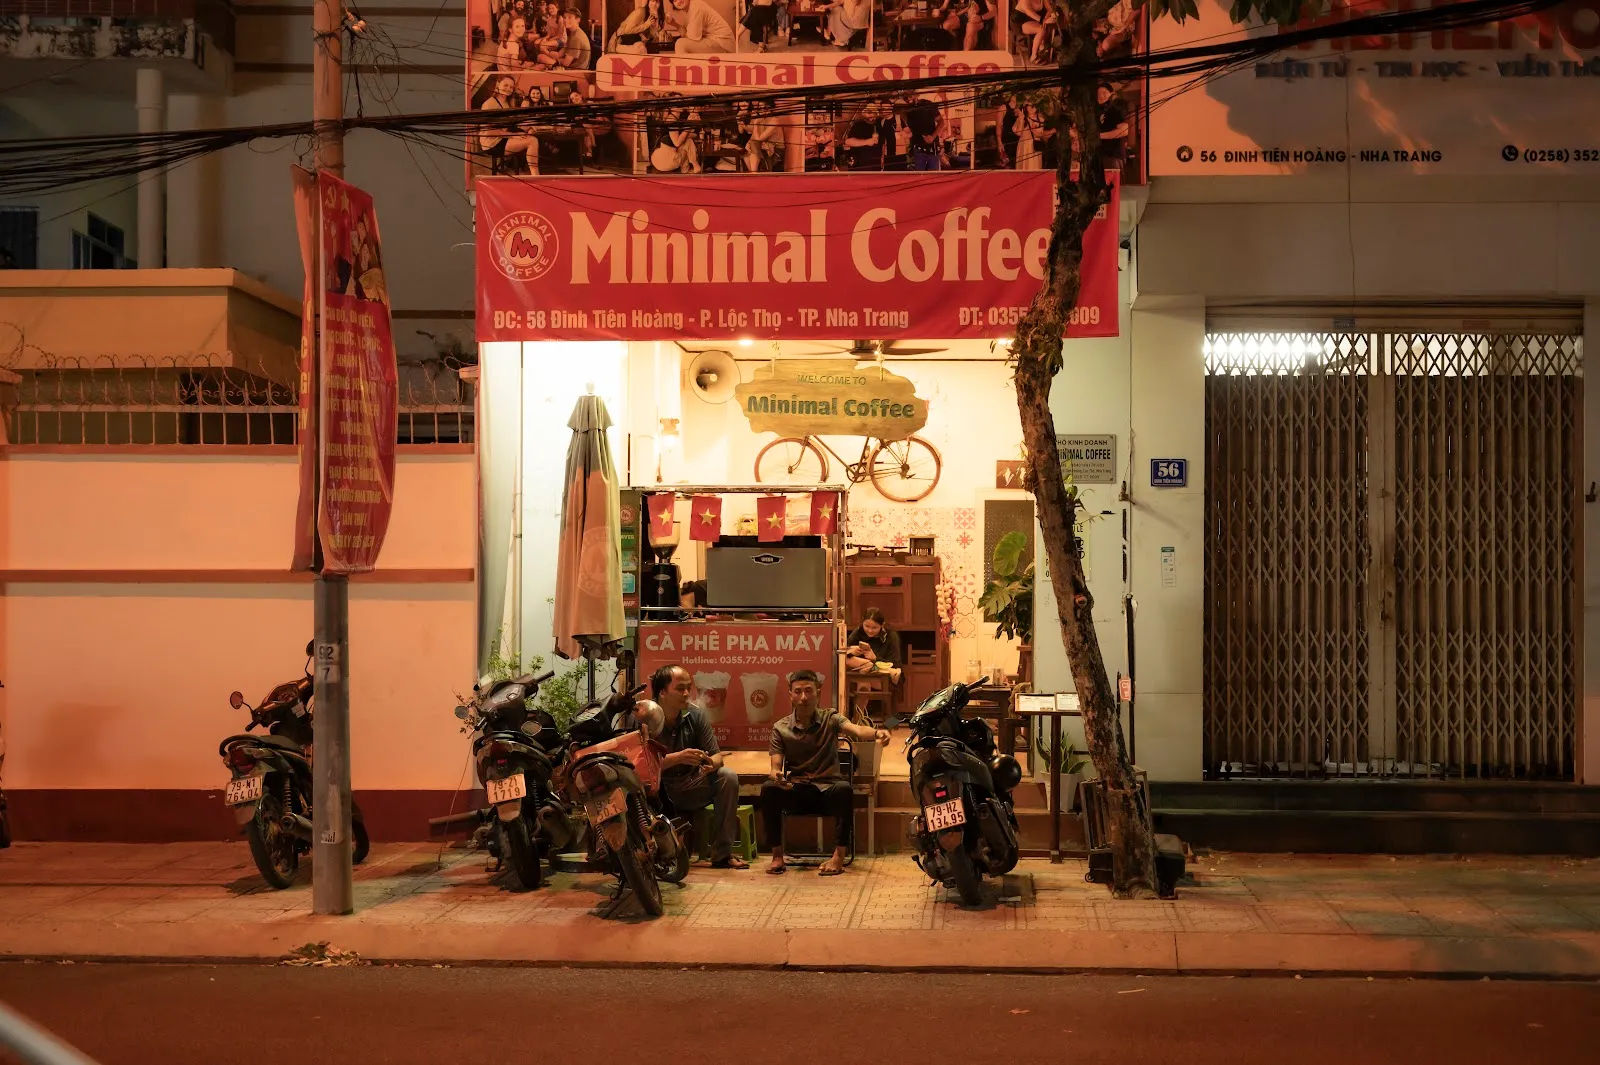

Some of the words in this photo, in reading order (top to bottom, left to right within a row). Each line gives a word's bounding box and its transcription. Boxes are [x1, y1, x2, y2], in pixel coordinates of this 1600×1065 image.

[610, 55, 815, 86] Minimal
[1200, 150, 1217, 162] 56
[1224, 150, 1258, 162] ĐINH
[1293, 146, 1346, 163] HOÀNG
[1360, 150, 1390, 162] NHA
[1394, 150, 1442, 162] TRANG
[1524, 148, 1569, 163] (0258)
[495, 215, 552, 242] MINIMAL
[569, 208, 828, 285] Minimal
[499, 255, 550, 277] COFFEE
[493, 310, 522, 329] ĐC:
[526, 310, 546, 329] 58
[550, 309, 588, 329] Đinh
[592, 308, 627, 329] Tiên
[631, 308, 684, 331] Hoàng
[700, 309, 713, 328] P.
[718, 308, 748, 332] Lộc
[752, 308, 782, 332] Thọ
[798, 308, 821, 327] TP.
[825, 308, 858, 327] Nha
[863, 307, 909, 328] Trang
[959, 307, 983, 326] ĐT:
[797, 374, 851, 385] WELCOME
[853, 375, 867, 385] TO
[747, 394, 838, 416] Minimal
[843, 398, 915, 418] Coffee
[1085, 448, 1111, 460] COFFEE
[1157, 462, 1180, 478] 56
[645, 630, 675, 651] CÀ
[681, 630, 720, 651] PHÊ
[726, 634, 769, 651] PHA
[775, 630, 825, 651] MÁY
[682, 656, 717, 664] Hotline:
[719, 656, 784, 665] 0355.77.9009
[493, 786, 521, 801] 1719
